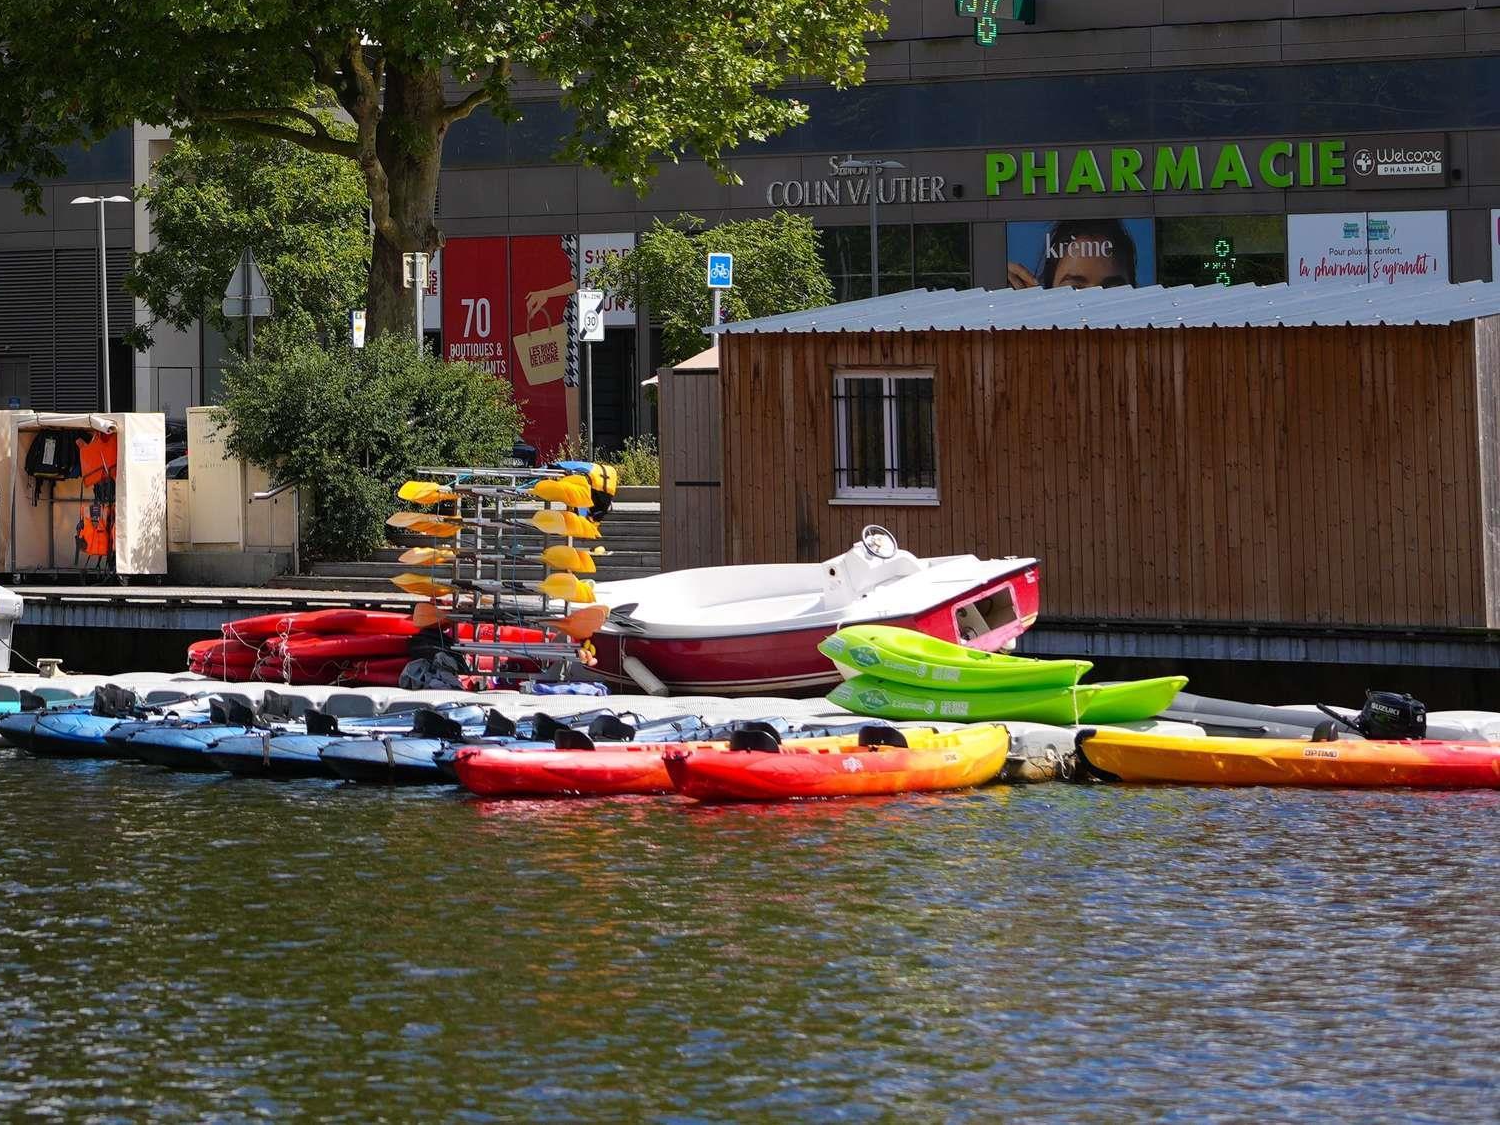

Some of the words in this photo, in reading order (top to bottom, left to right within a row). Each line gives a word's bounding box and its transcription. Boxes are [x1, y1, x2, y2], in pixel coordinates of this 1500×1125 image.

[1376, 148, 1442, 165] Welcome
[985, 140, 1347, 196] PHARMACIE
[1384, 165, 1436, 173] PHARMACIE
[766, 179, 840, 207] COLIN
[1045, 232, 1113, 259] krème
[1329, 247, 1347, 256] Pour
[1347, 247, 1362, 257] plus
[461, 297, 491, 338] 70
[586, 316, 596, 327] 30
[450, 342, 494, 358] BOUTIQUES
[496, 341, 503, 357] &
[1371, 701, 1400, 716] SUZUKI
